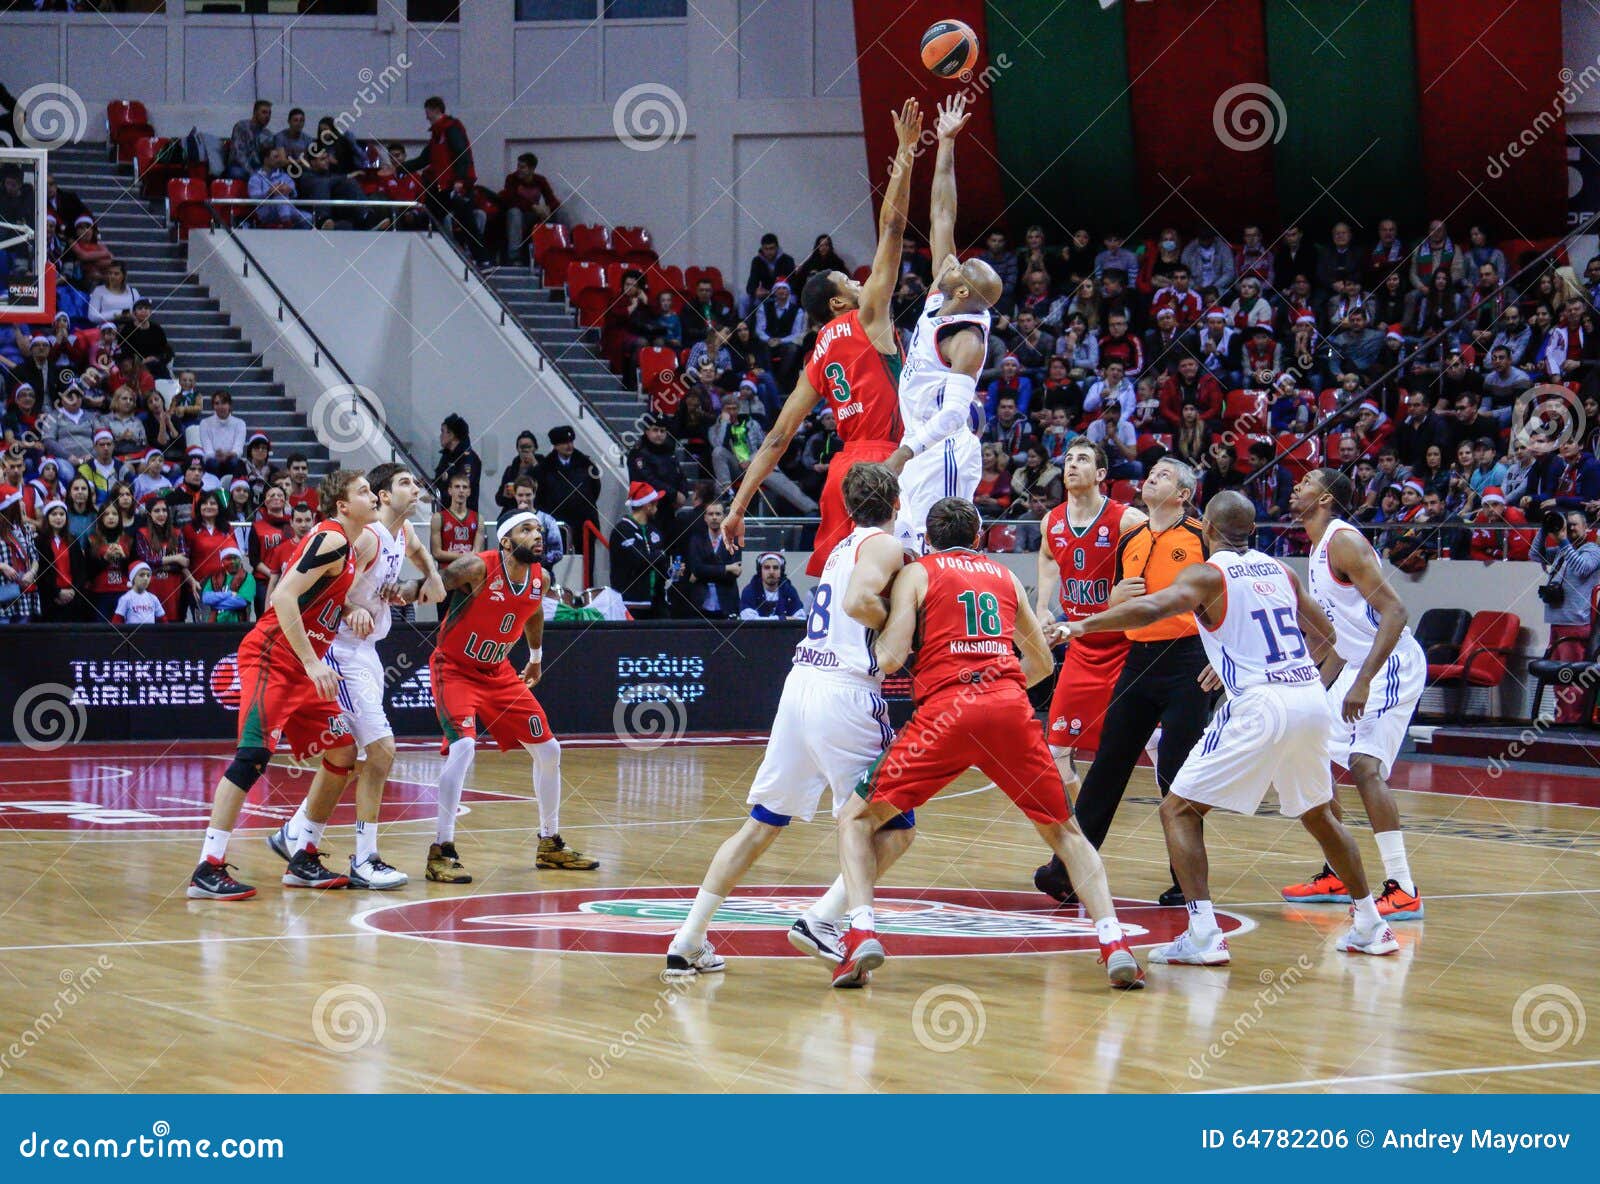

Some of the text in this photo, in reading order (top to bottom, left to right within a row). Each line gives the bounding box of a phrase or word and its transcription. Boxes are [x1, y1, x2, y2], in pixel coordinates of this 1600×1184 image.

[824, 361, 852, 403] 3
[936, 556, 1003, 579] VORONOV
[1073, 548, 1085, 570] 9
[1227, 562, 1282, 579] GRANGER
[500, 613, 516, 633] 0
[807, 583, 832, 641] 8
[957, 590, 1002, 637] 18
[1251, 607, 1306, 664] 15
[950, 640, 1009, 656] KRASNODAR
[69, 660, 205, 682] TURKISH
[69, 684, 205, 705] AIRLINES
[618, 683, 704, 703] GROUP
[528, 714, 543, 736] 0
